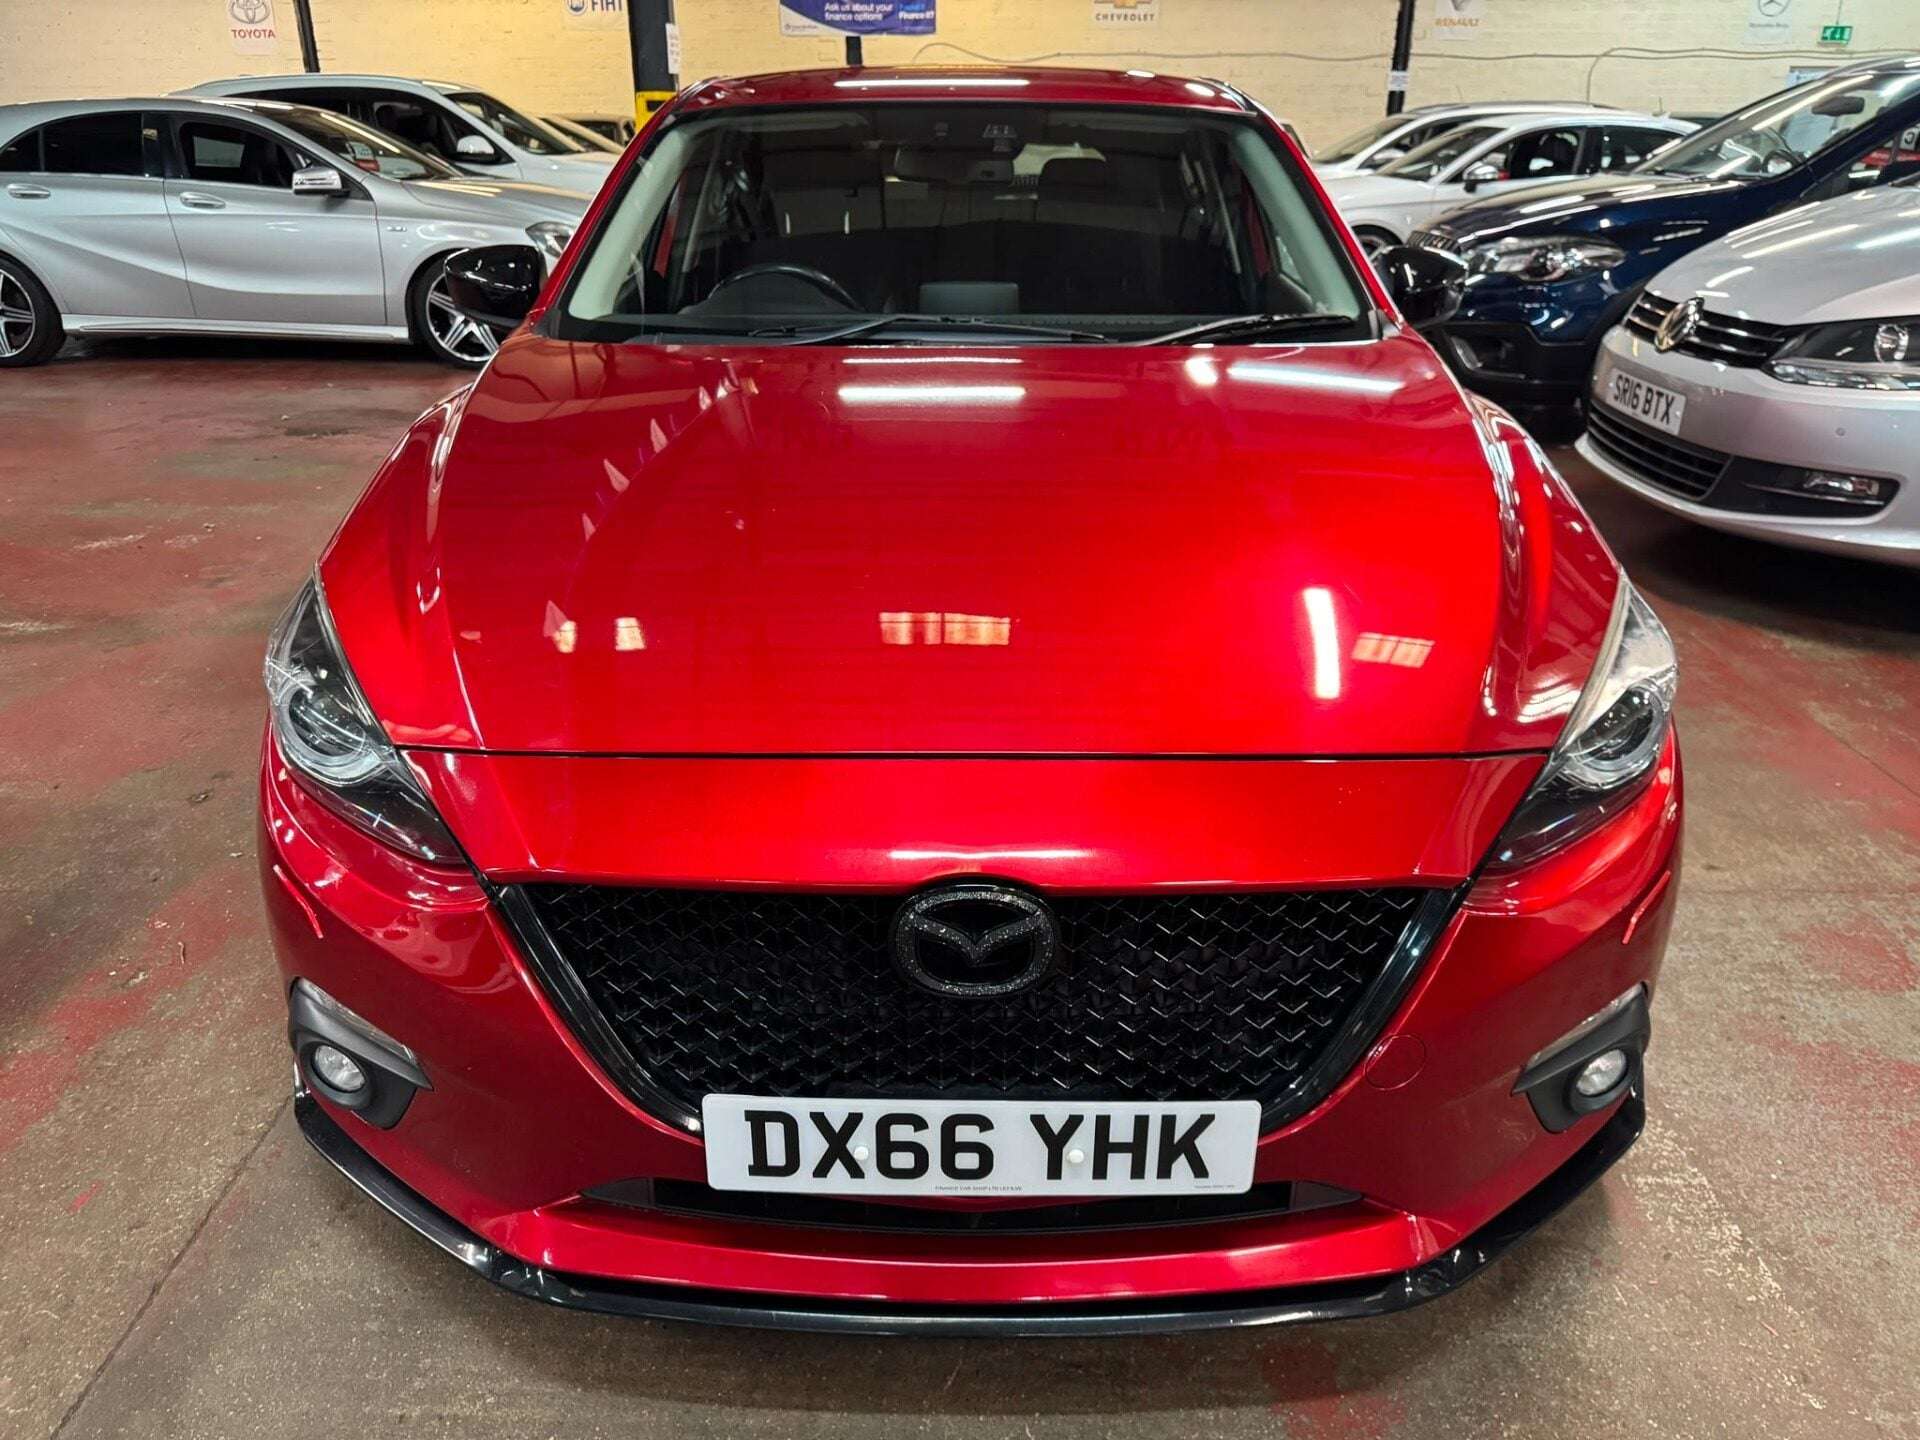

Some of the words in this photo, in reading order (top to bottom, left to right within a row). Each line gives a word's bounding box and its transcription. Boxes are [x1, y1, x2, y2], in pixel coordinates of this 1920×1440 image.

[824, 3, 840, 11] Ask
[852, 3, 874, 11] about
[875, 4, 893, 13] your
[825, 12, 852, 21] finance
[1095, 13, 1154, 21] CHEVROLET
[231, 29, 276, 39] TOYOTA
[1613, 374, 1642, 410] SR16
[1642, 386, 1676, 425] BTX
[744, 1110, 994, 1181] DX66
[1029, 1113, 1216, 1180] YHK
